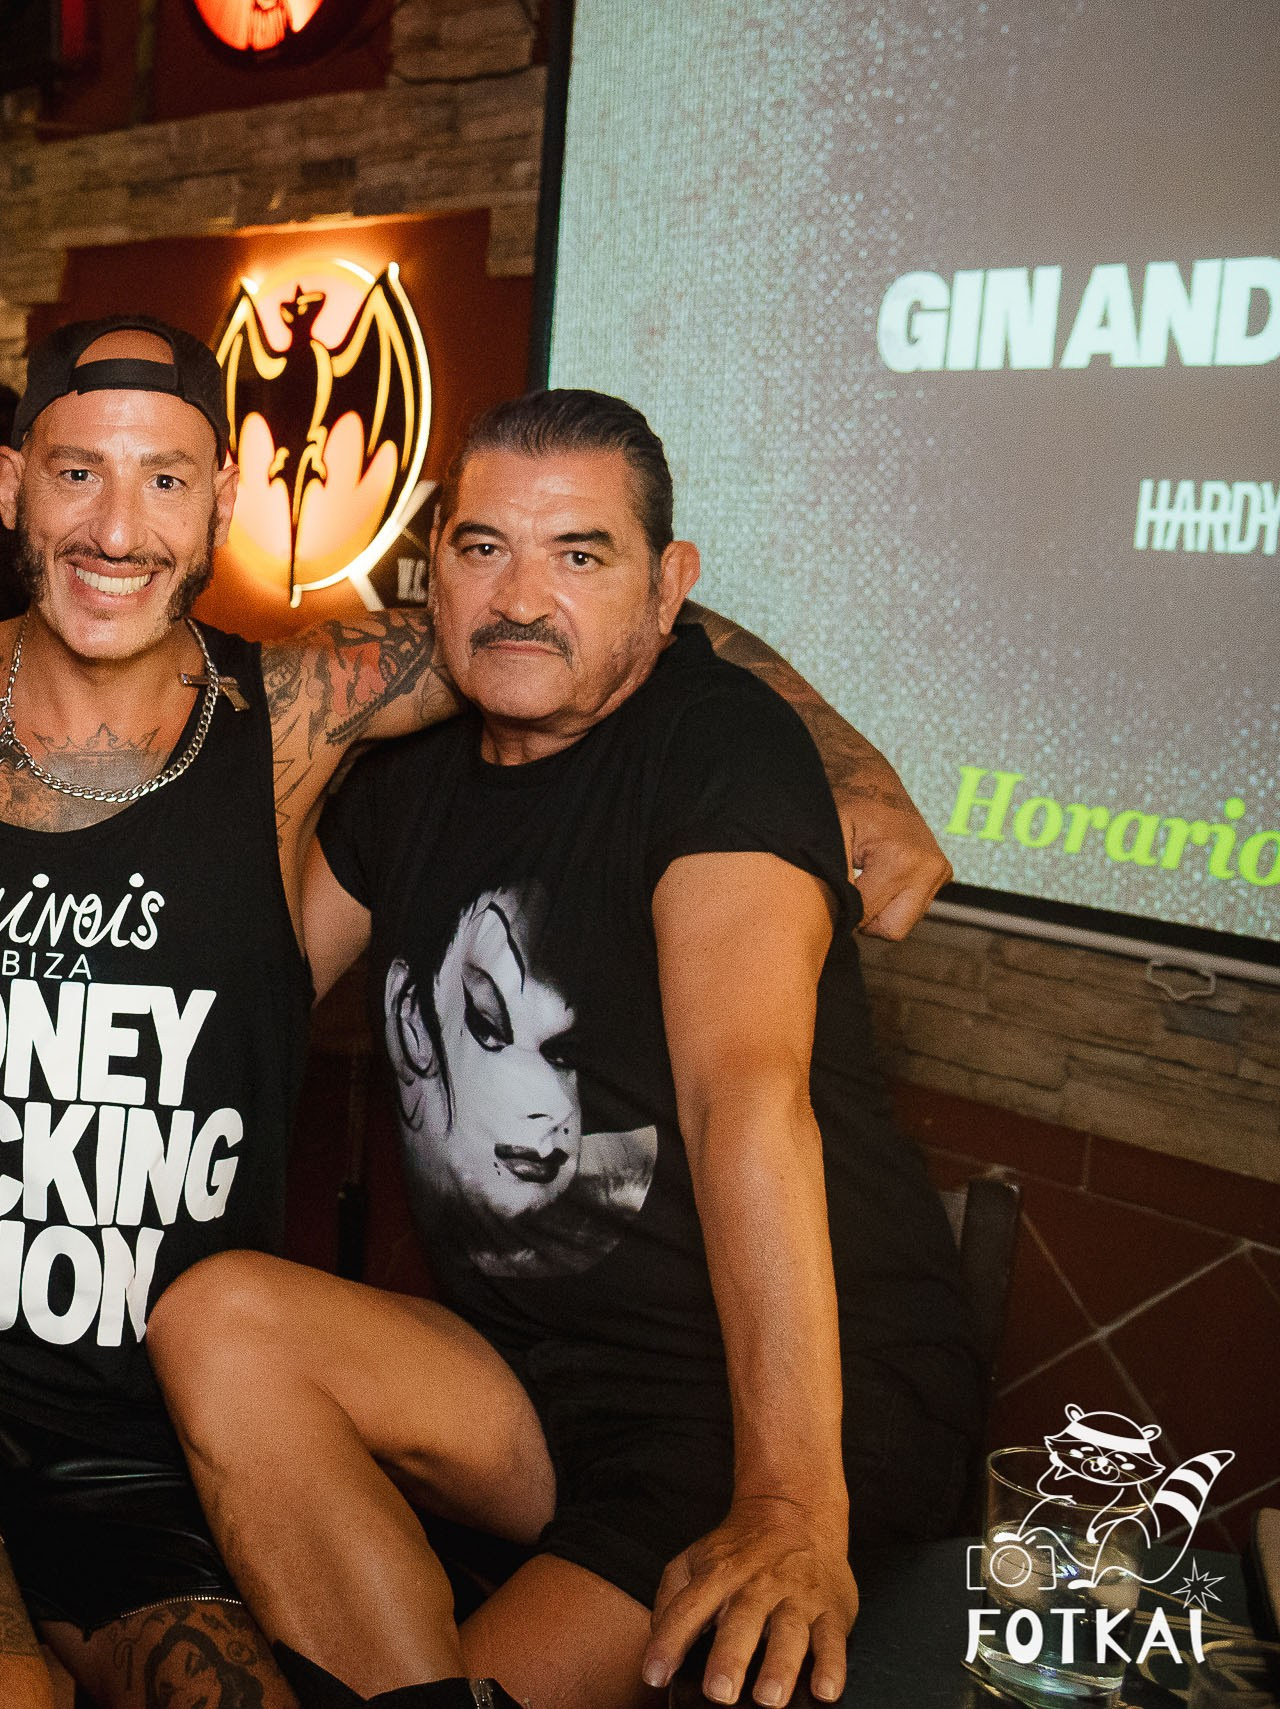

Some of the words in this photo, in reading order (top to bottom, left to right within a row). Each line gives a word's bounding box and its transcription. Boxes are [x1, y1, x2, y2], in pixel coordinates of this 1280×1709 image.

[876, 263, 1062, 373] GIN
[1059, 255, 1280, 370] AND
[944, 765, 1280, 887] Horario
